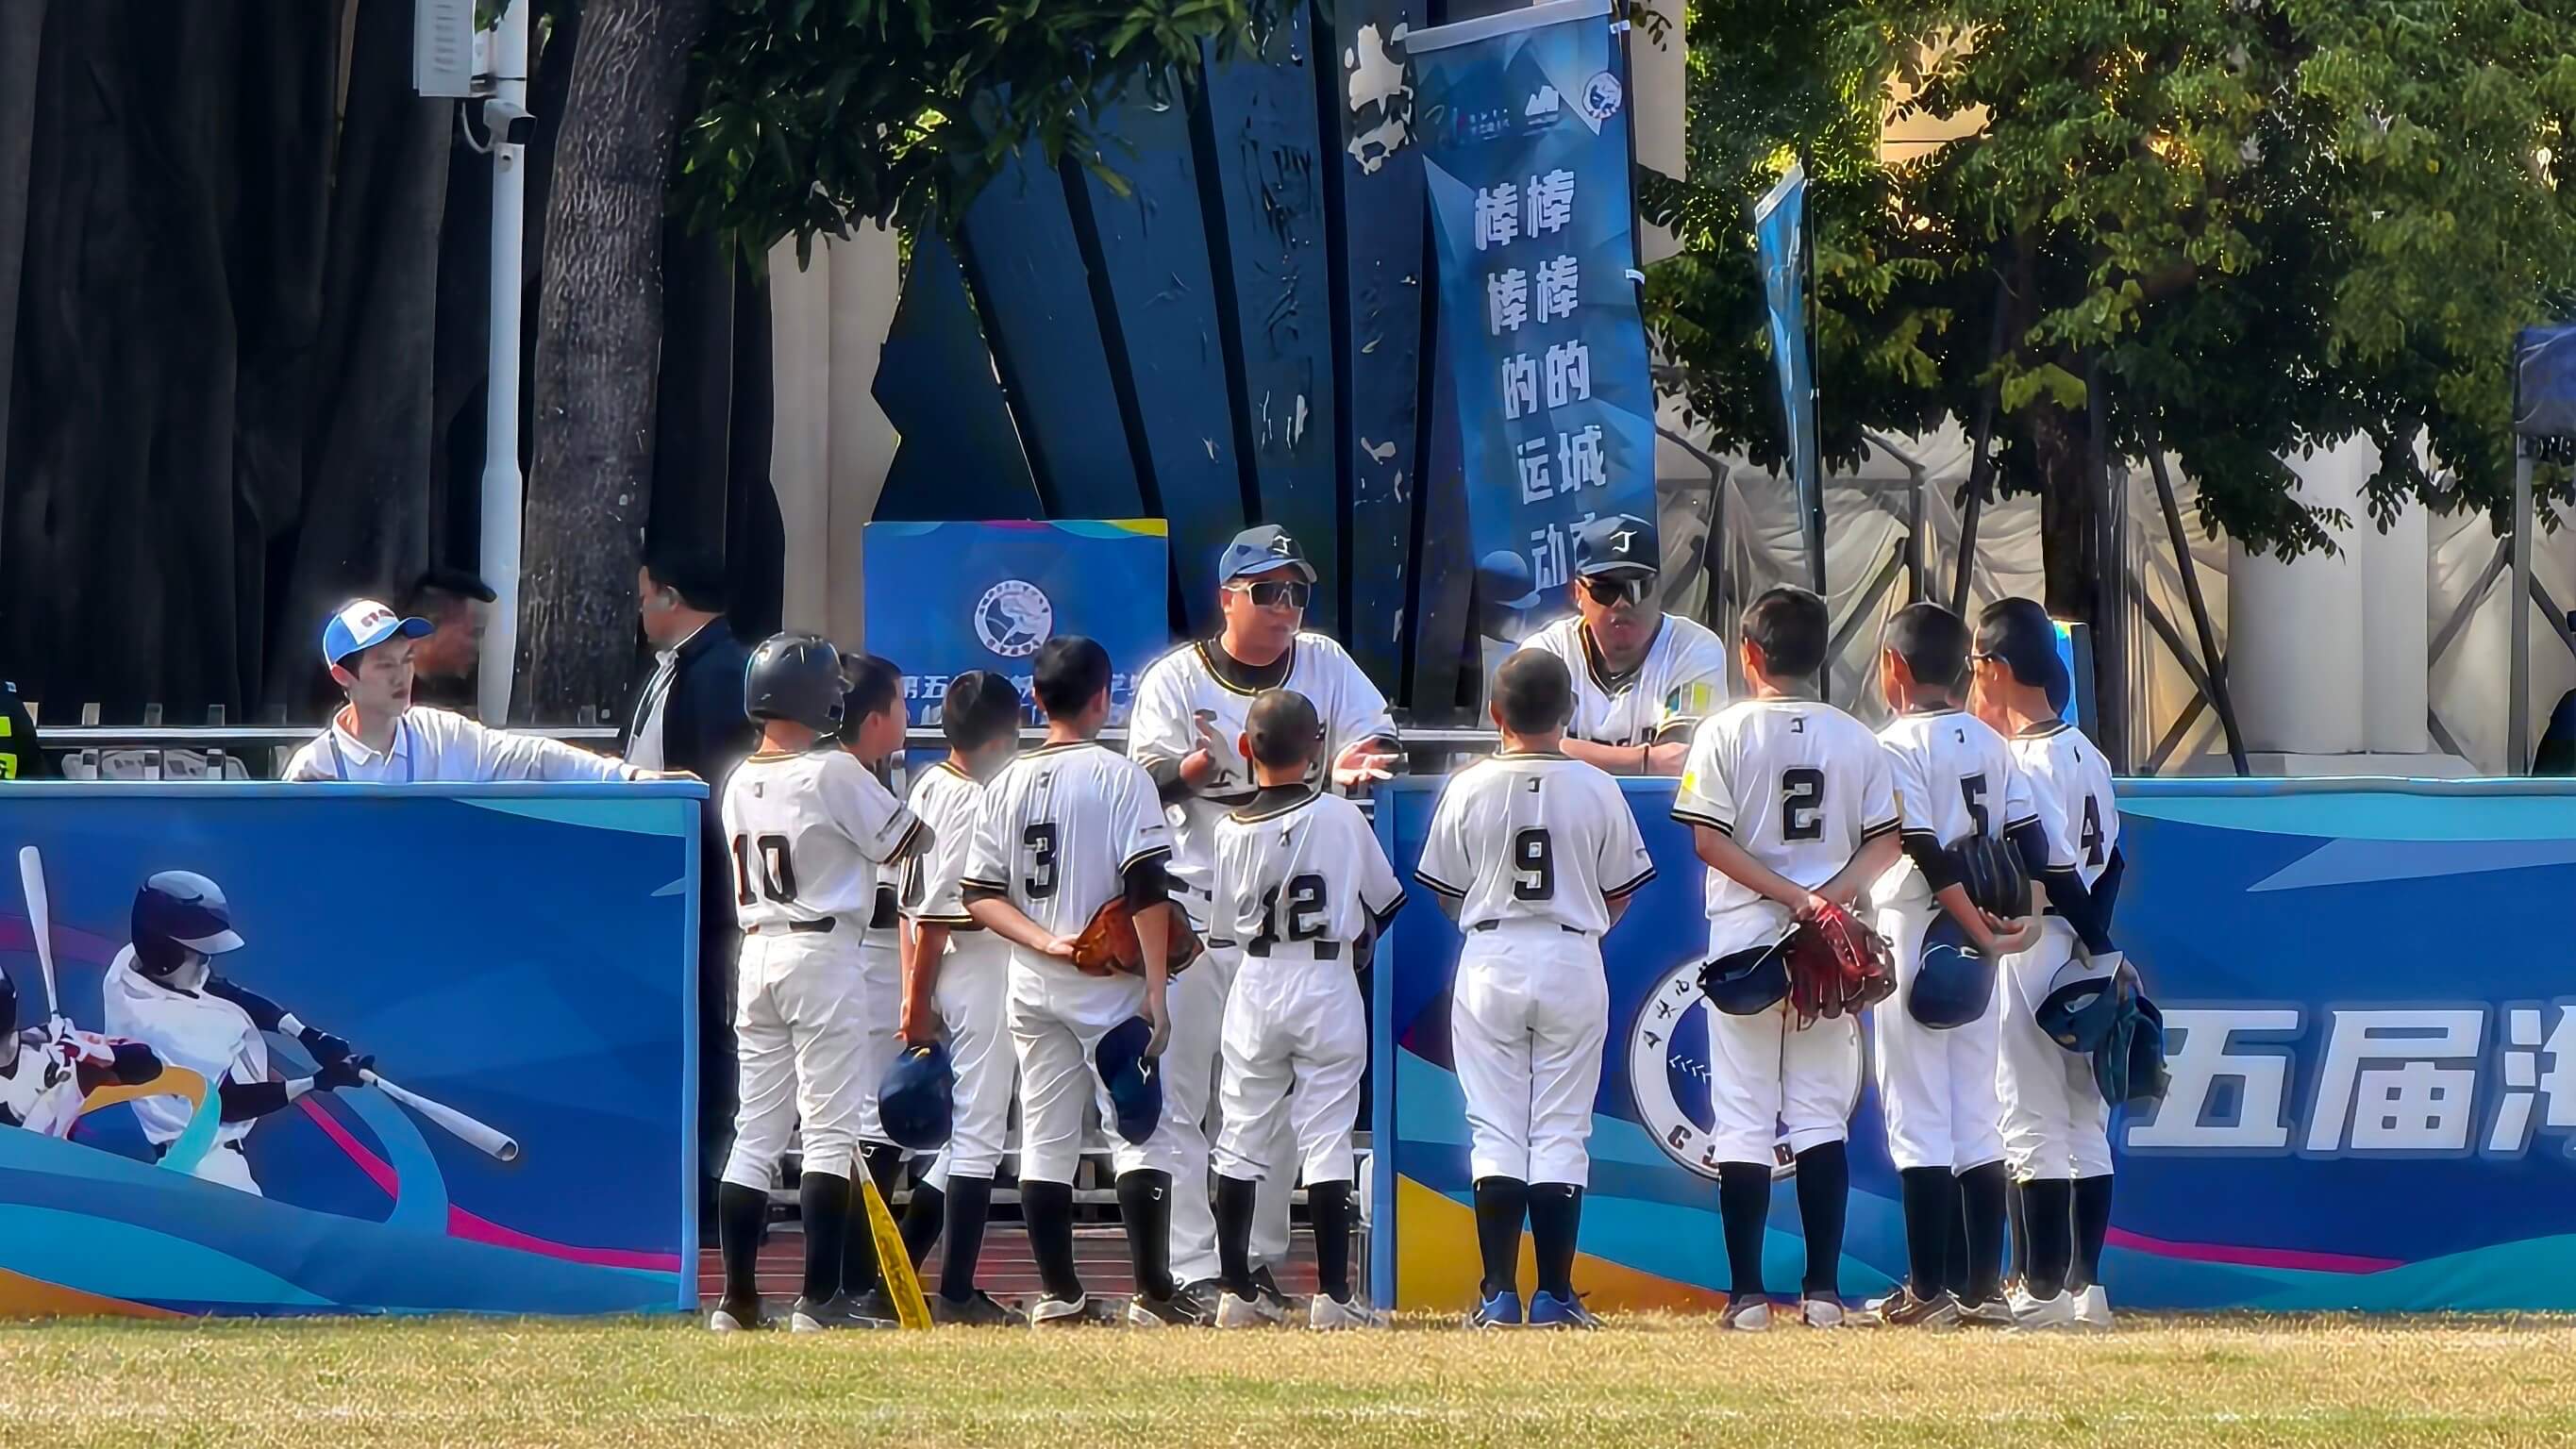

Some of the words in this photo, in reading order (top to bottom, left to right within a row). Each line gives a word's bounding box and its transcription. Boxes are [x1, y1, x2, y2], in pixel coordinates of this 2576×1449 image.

[1475, 182, 1568, 590] 棒棒的运动
[1781, 767, 1825, 841] 2
[1959, 773, 1989, 837] 5
[2079, 792, 2105, 870] 4
[732, 833, 798, 907] 10
[1023, 822, 1058, 899] 3
[1513, 826, 1555, 901] 9
[1261, 873, 1329, 943] 12
